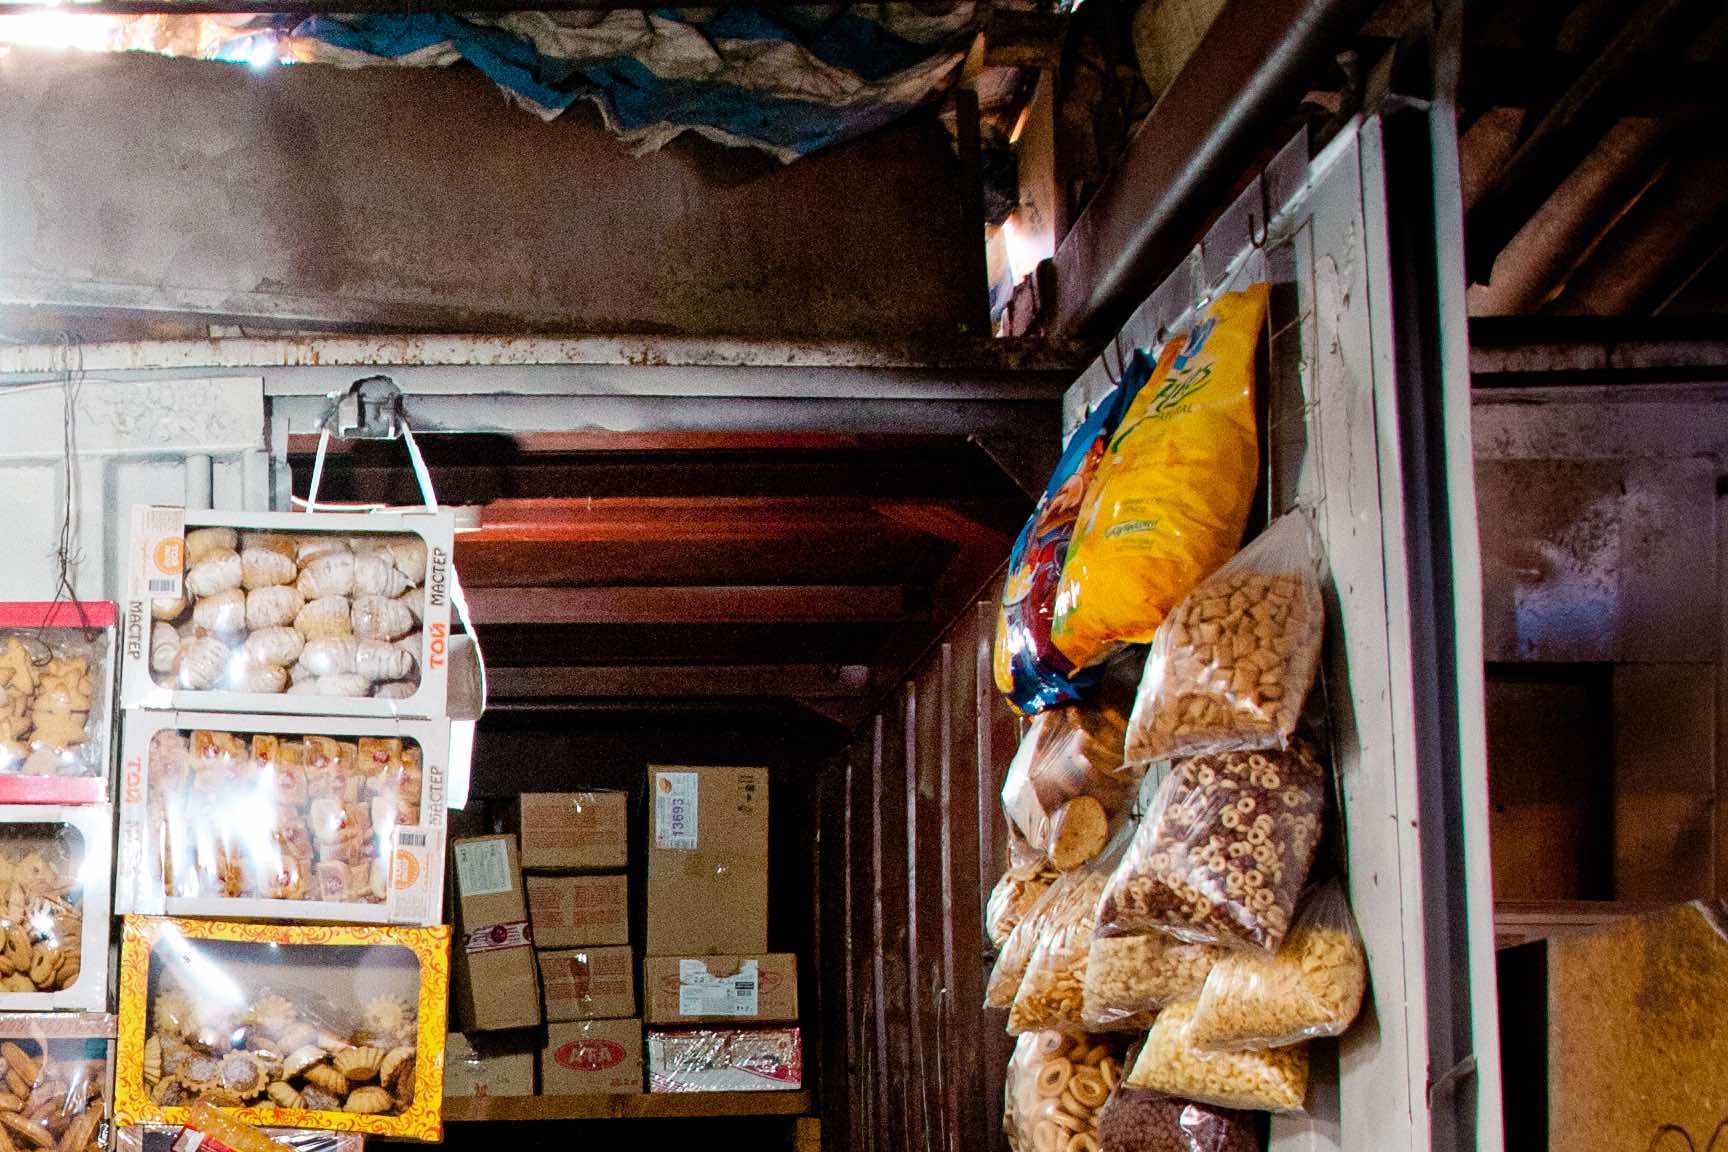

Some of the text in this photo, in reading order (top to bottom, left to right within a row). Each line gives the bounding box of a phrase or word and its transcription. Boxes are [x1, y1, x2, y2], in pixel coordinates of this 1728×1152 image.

[127, 600, 143, 661] МАСТЕР
[428, 547, 448, 669] ТОЙ МАСТЕР
[123, 756, 142, 807] ТОЙ
